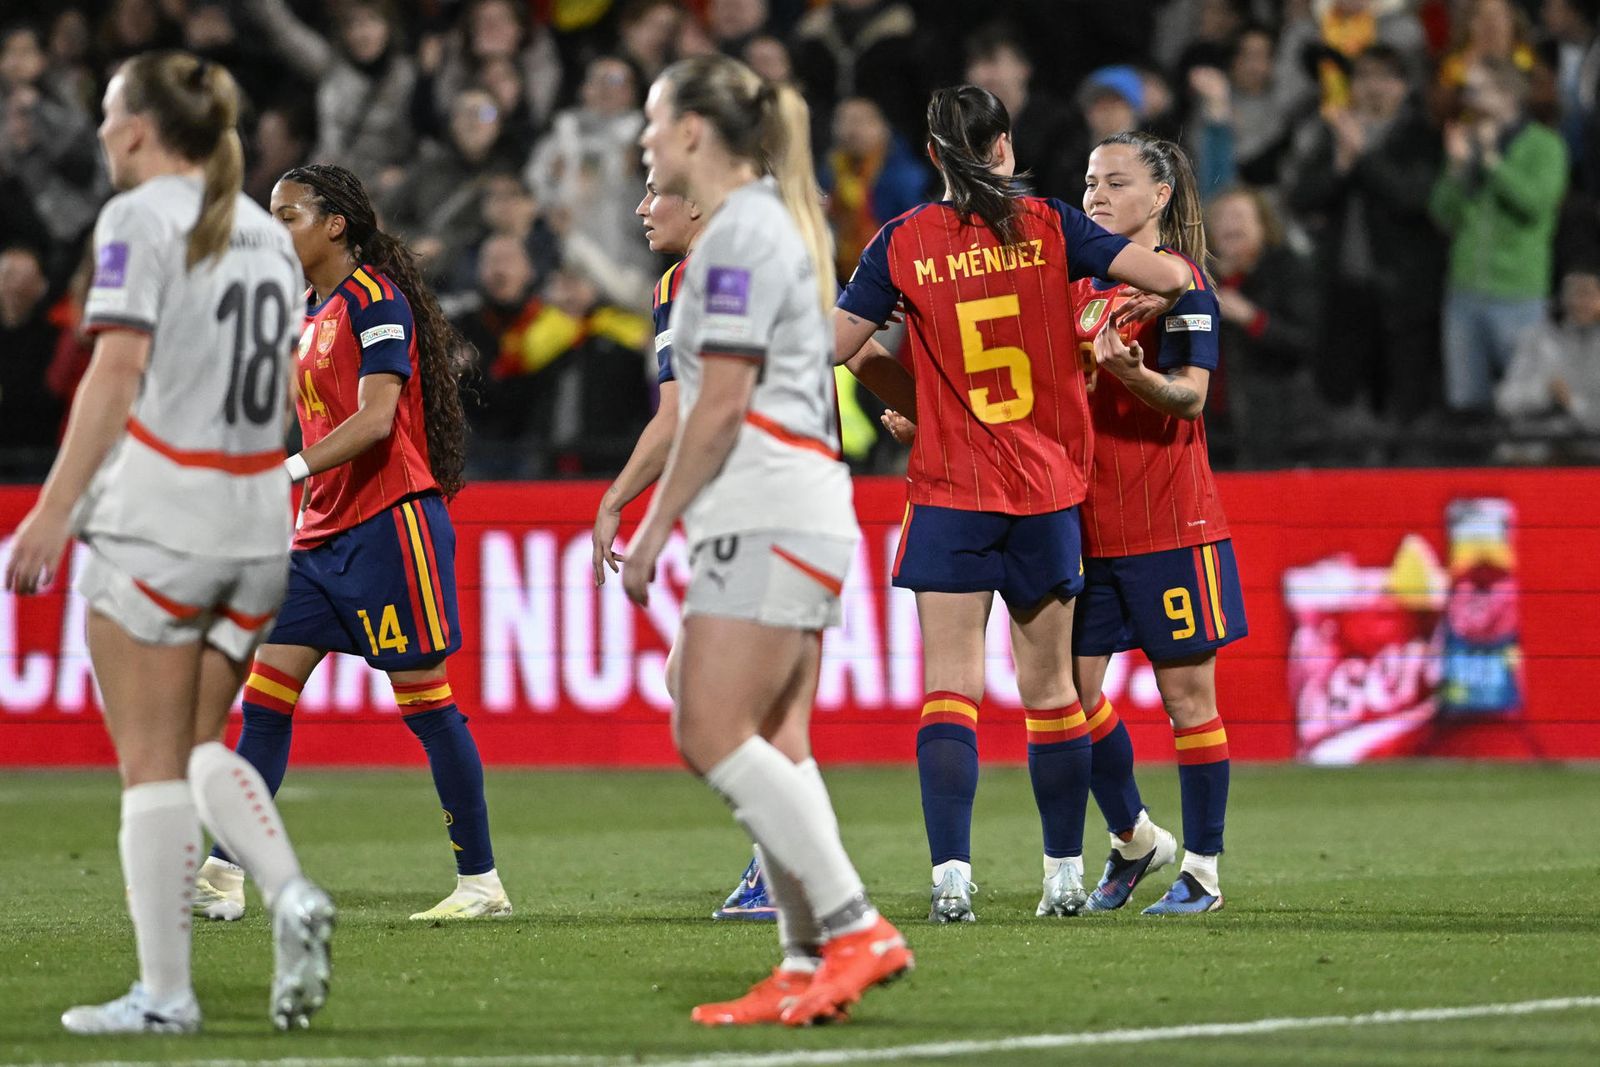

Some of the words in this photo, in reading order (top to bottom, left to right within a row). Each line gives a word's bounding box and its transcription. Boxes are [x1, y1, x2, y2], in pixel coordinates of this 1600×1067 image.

[914, 257, 943, 286] M.
[945, 239, 1046, 281] MÉNDEZ
[216, 280, 288, 426] 18
[955, 293, 1035, 425] 5
[356, 603, 409, 656] 14
[1163, 587, 1196, 641] 9
